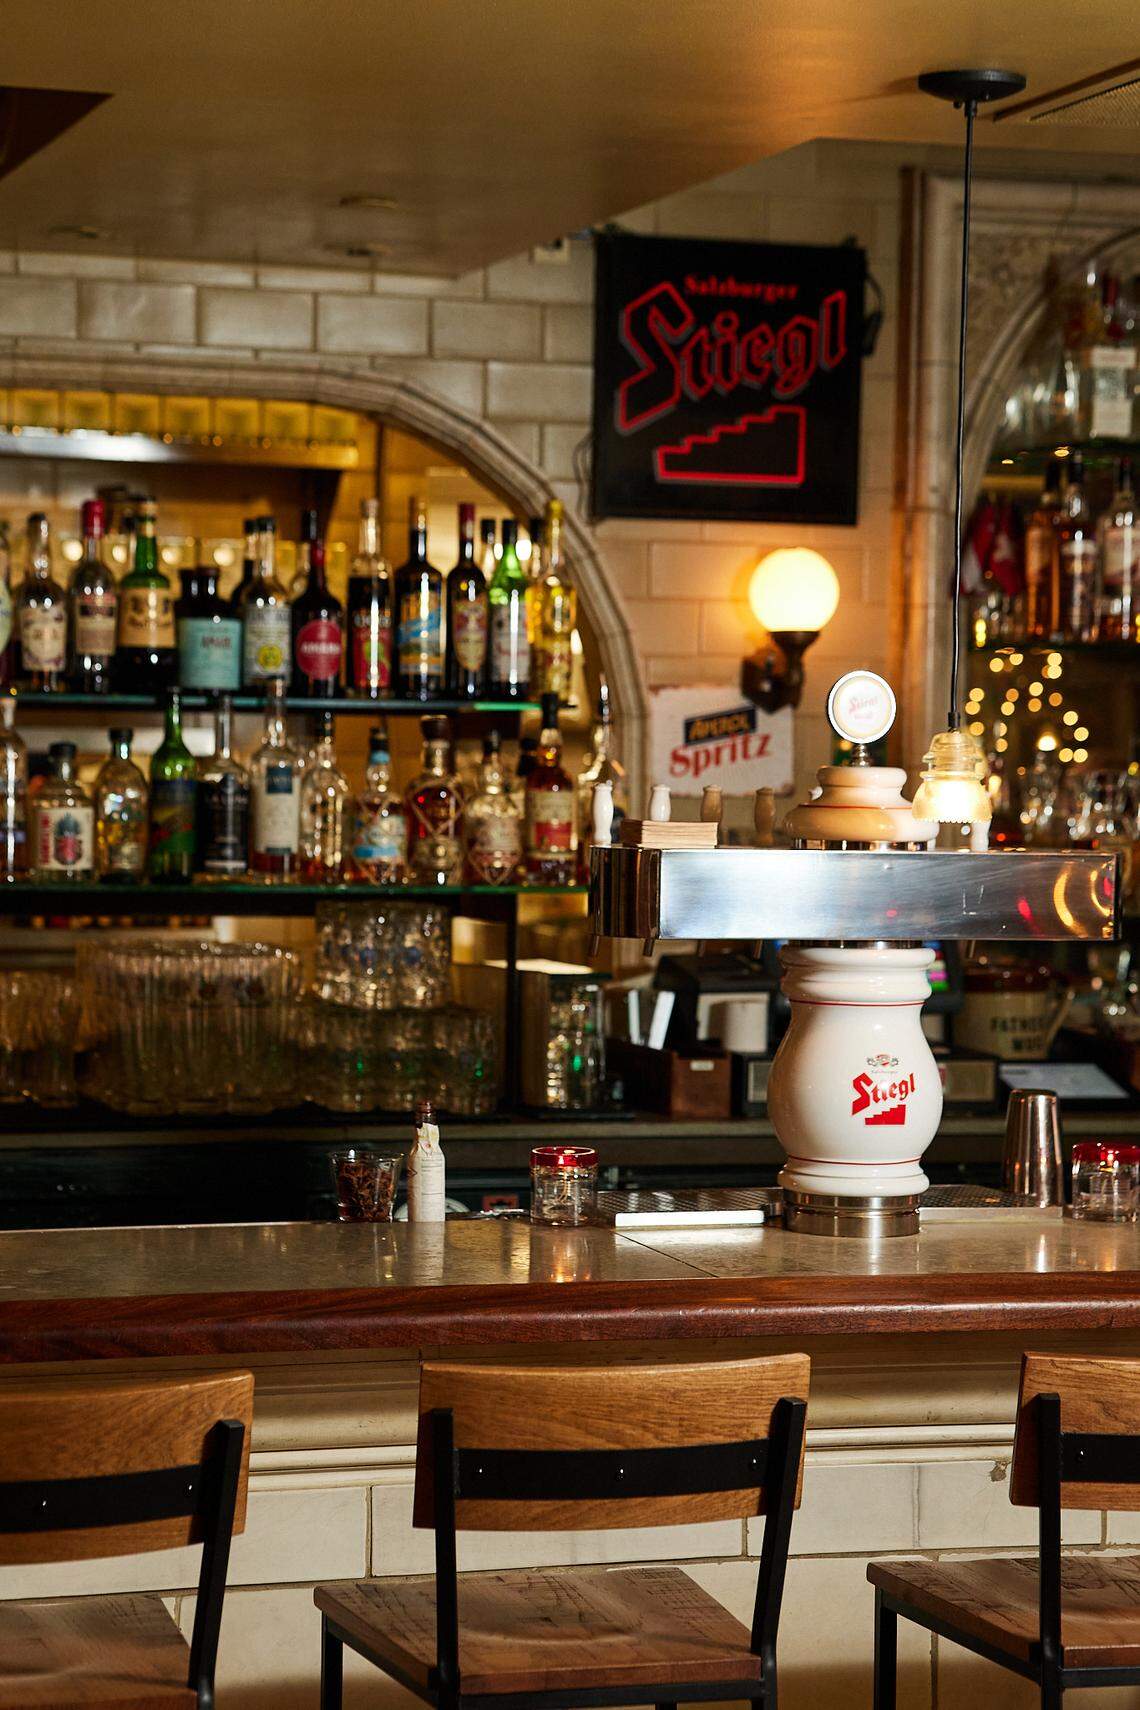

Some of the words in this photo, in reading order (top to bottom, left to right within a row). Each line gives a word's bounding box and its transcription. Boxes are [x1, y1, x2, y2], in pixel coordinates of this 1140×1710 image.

[616, 281, 848, 432] Stiegl
[669, 732, 774, 779] Spritz
[851, 1072, 916, 1117] Stiegl
